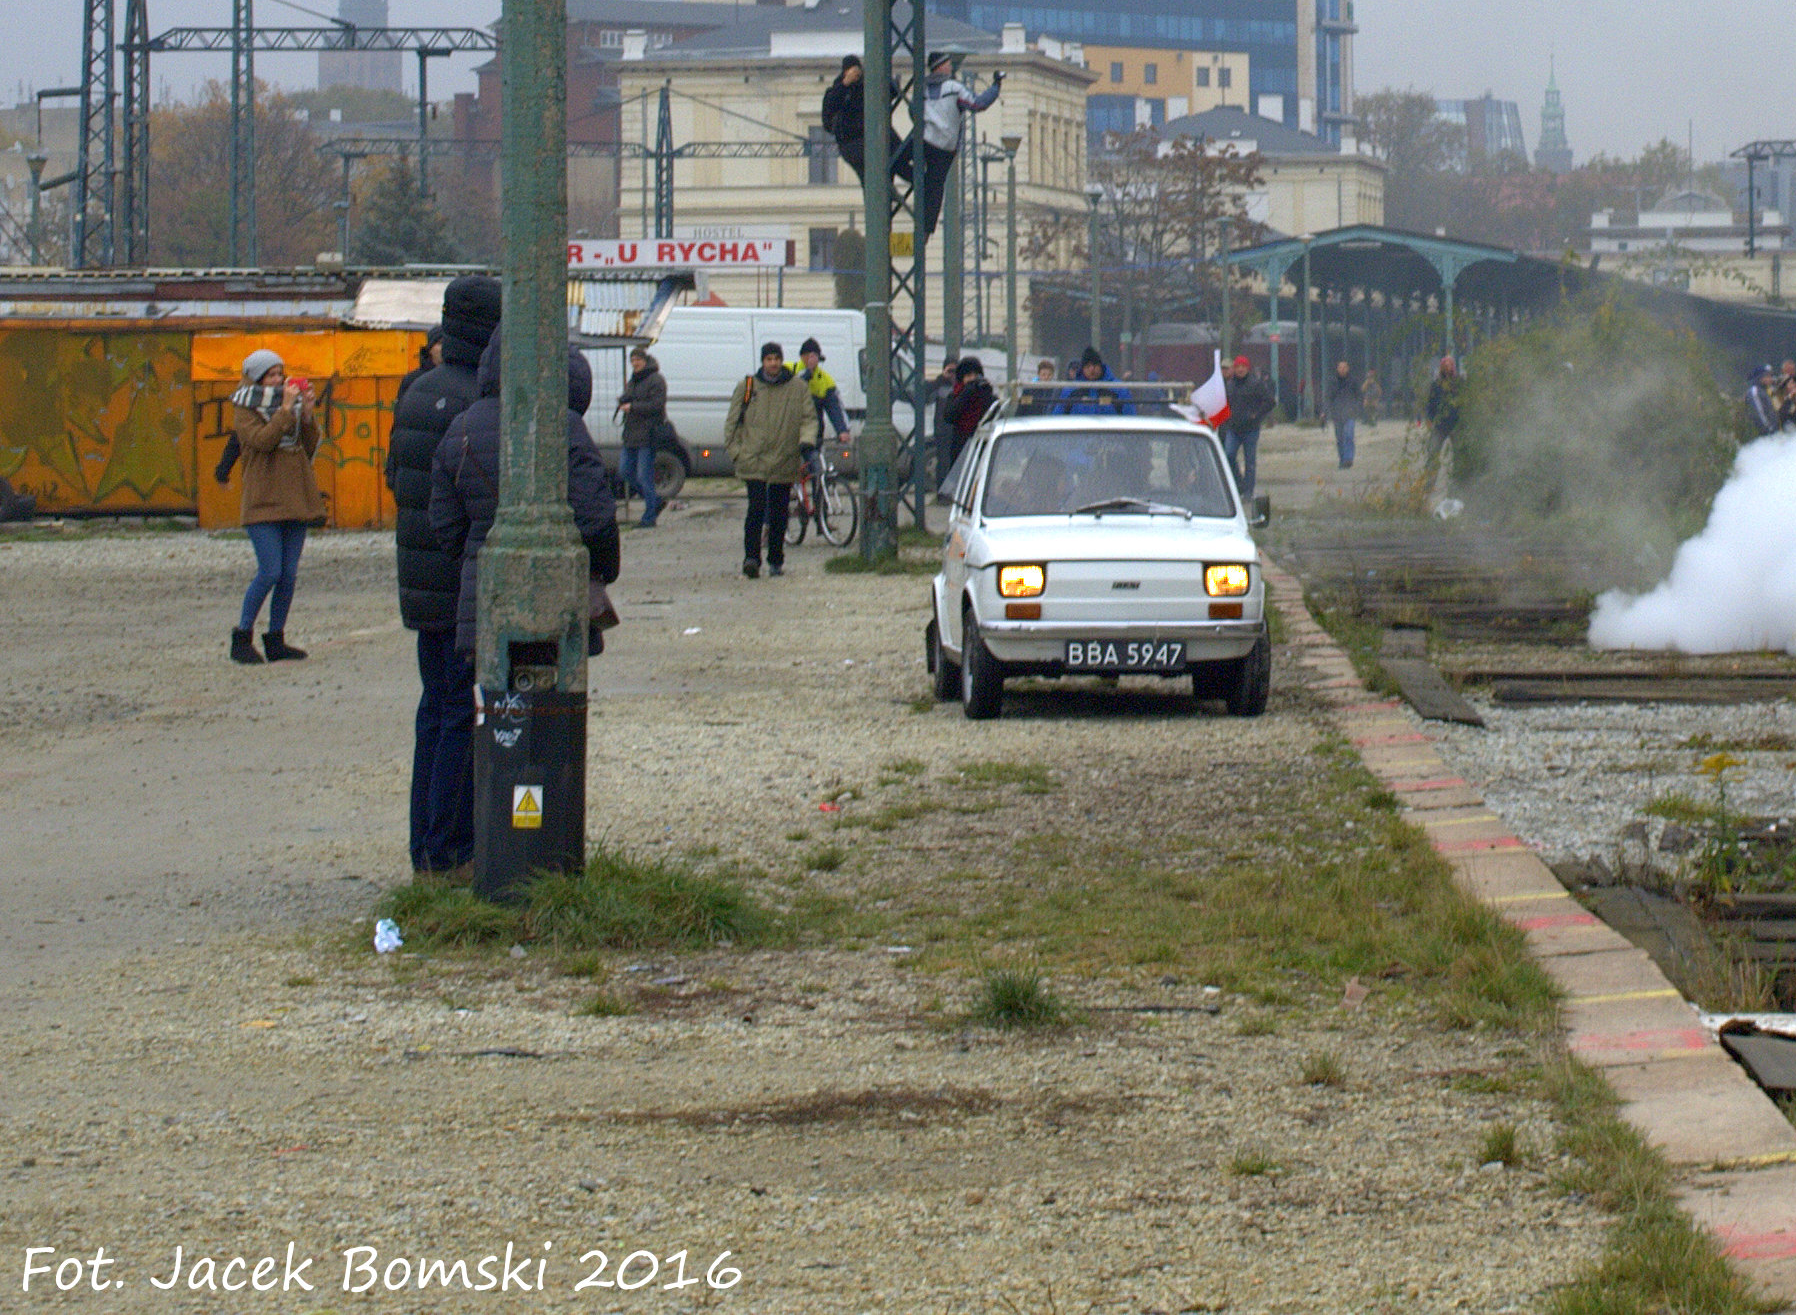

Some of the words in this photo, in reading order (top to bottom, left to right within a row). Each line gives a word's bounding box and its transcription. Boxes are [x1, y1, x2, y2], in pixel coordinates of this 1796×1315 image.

[693, 226, 745, 240] HOSTEL
[1068, 642, 1119, 666] BBA
[1126, 642, 1182, 666] 5947
